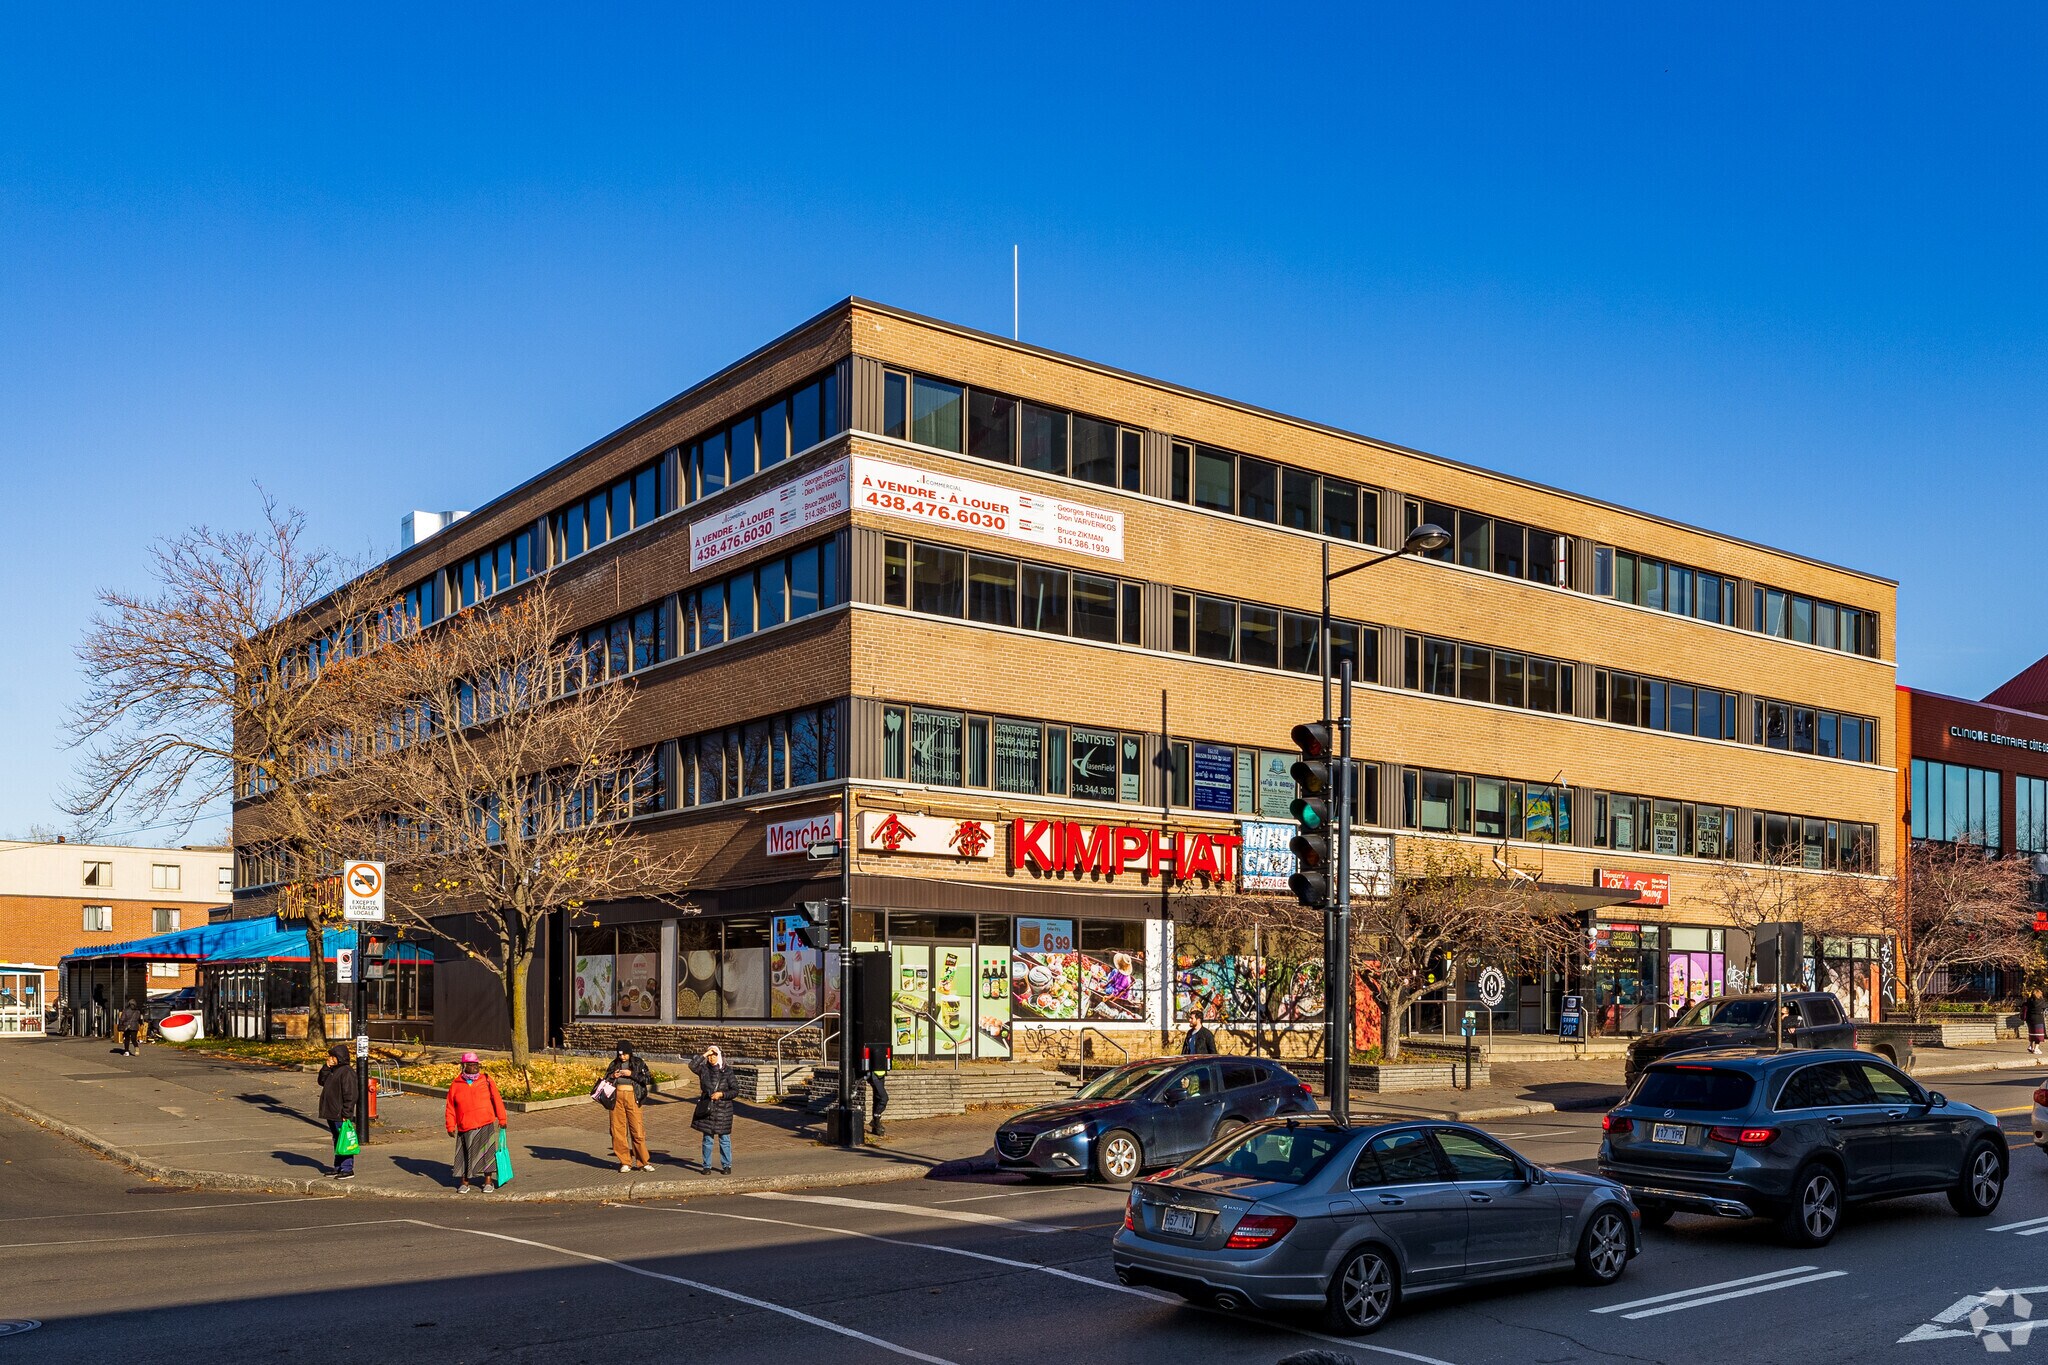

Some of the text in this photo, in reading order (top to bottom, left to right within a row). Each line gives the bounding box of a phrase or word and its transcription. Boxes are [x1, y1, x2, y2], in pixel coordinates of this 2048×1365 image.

[804, 464, 845, 487] Georges RENAUD
[804, 487, 816, 497] Dion
[815, 473, 847, 494] VARVERIKOS
[804, 491, 837, 511] Bruce ZIKMAN
[862, 475, 872, 486] À
[877, 479, 937, 500] VENDRE
[949, 492, 958, 504] À
[963, 498, 1010, 514] LOUER
[804, 500, 842, 521] 514.386.1939
[866, 492, 1006, 530] 438.476.6030
[1058, 504, 1114, 522] Georges RENAUD
[694, 537, 701, 548] À
[702, 526, 733, 545] VENDRE
[739, 518, 746, 529] À
[747, 507, 775, 526] LOUER
[1058, 513, 1117, 532] Dion VARVERIKOS
[697, 521, 773, 562] 438.476.6030
[1058, 526, 1104, 542] Bruce ZIKMAN
[1058, 536, 1110, 554] 514.386.1939
[912, 713, 961, 728] DENTISTES
[996, 724, 1038, 736] DENTISTERIE
[1032, 740, 1040, 748] ET
[1072, 733, 1115, 747] DENTISTES
[1951, 726, 1988, 742] CLINIQUE
[1990, 733, 2028, 748] DENTAIRE
[1072, 784, 1115, 796] 514.344.1810
[771, 818, 831, 853] Marché
[1698, 830, 1719, 843] JOHN
[1012, 818, 1244, 882] KIMPHAT
[1044, 932, 1070, 952] 6 99
[1672, 1128, 1684, 1138] YPR
[1166, 1212, 1194, 1228] H57 TVJ
